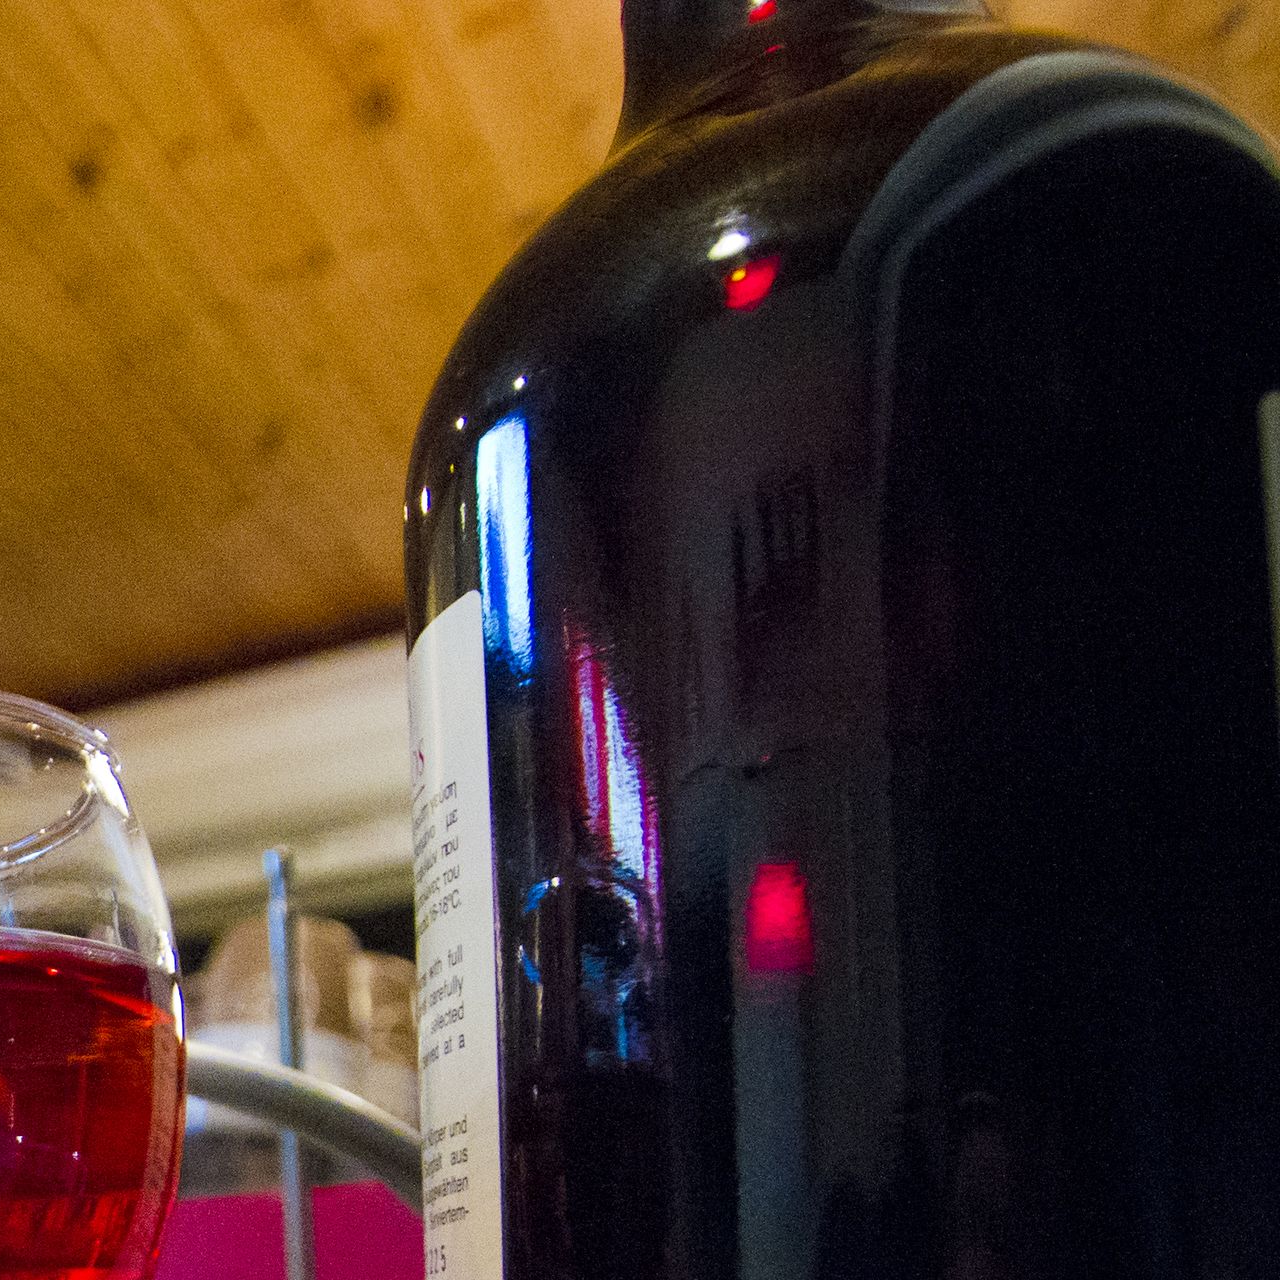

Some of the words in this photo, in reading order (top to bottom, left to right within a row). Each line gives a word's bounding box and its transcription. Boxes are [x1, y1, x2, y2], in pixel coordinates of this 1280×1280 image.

[448, 944, 463, 967] full
[444, 1036, 452, 1055] at
[459, 1034, 466, 1049] a
[449, 1114, 467, 1138] und
[450, 1147, 468, 1166] aus
